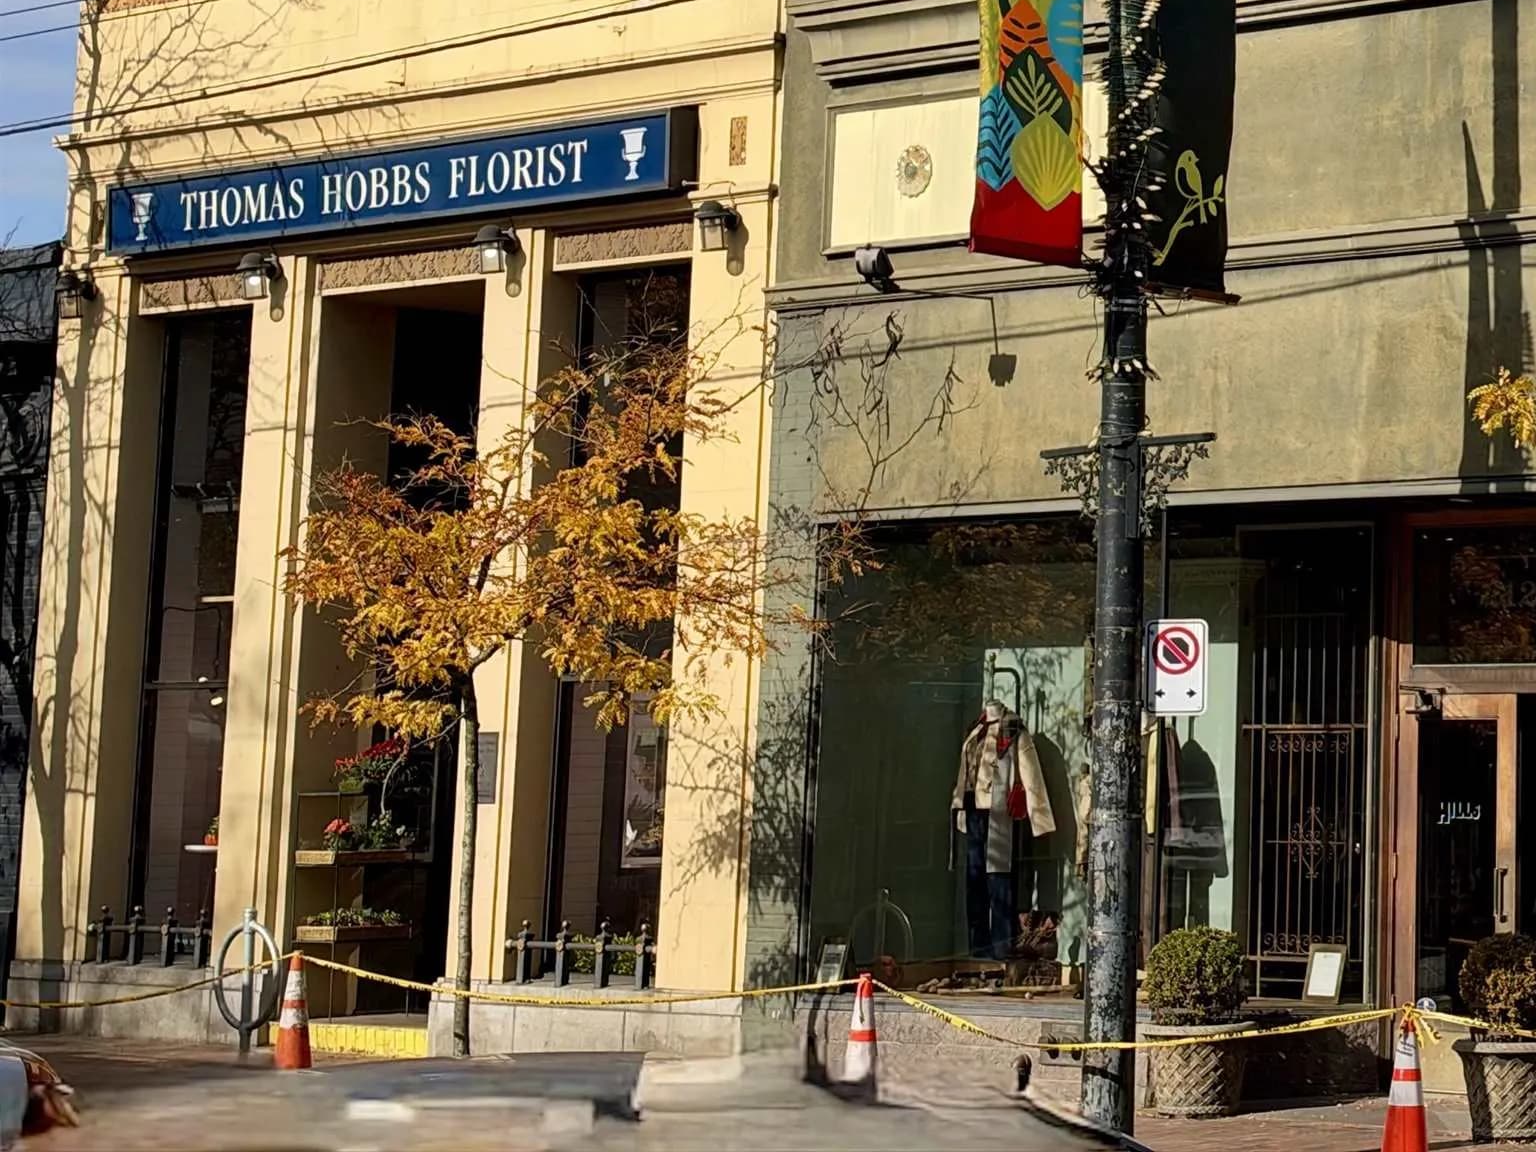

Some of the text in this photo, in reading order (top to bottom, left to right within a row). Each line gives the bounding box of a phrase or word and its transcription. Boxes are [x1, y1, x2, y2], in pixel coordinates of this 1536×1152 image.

[180, 138, 588, 232] THOMAS HOBBS FLORIST
